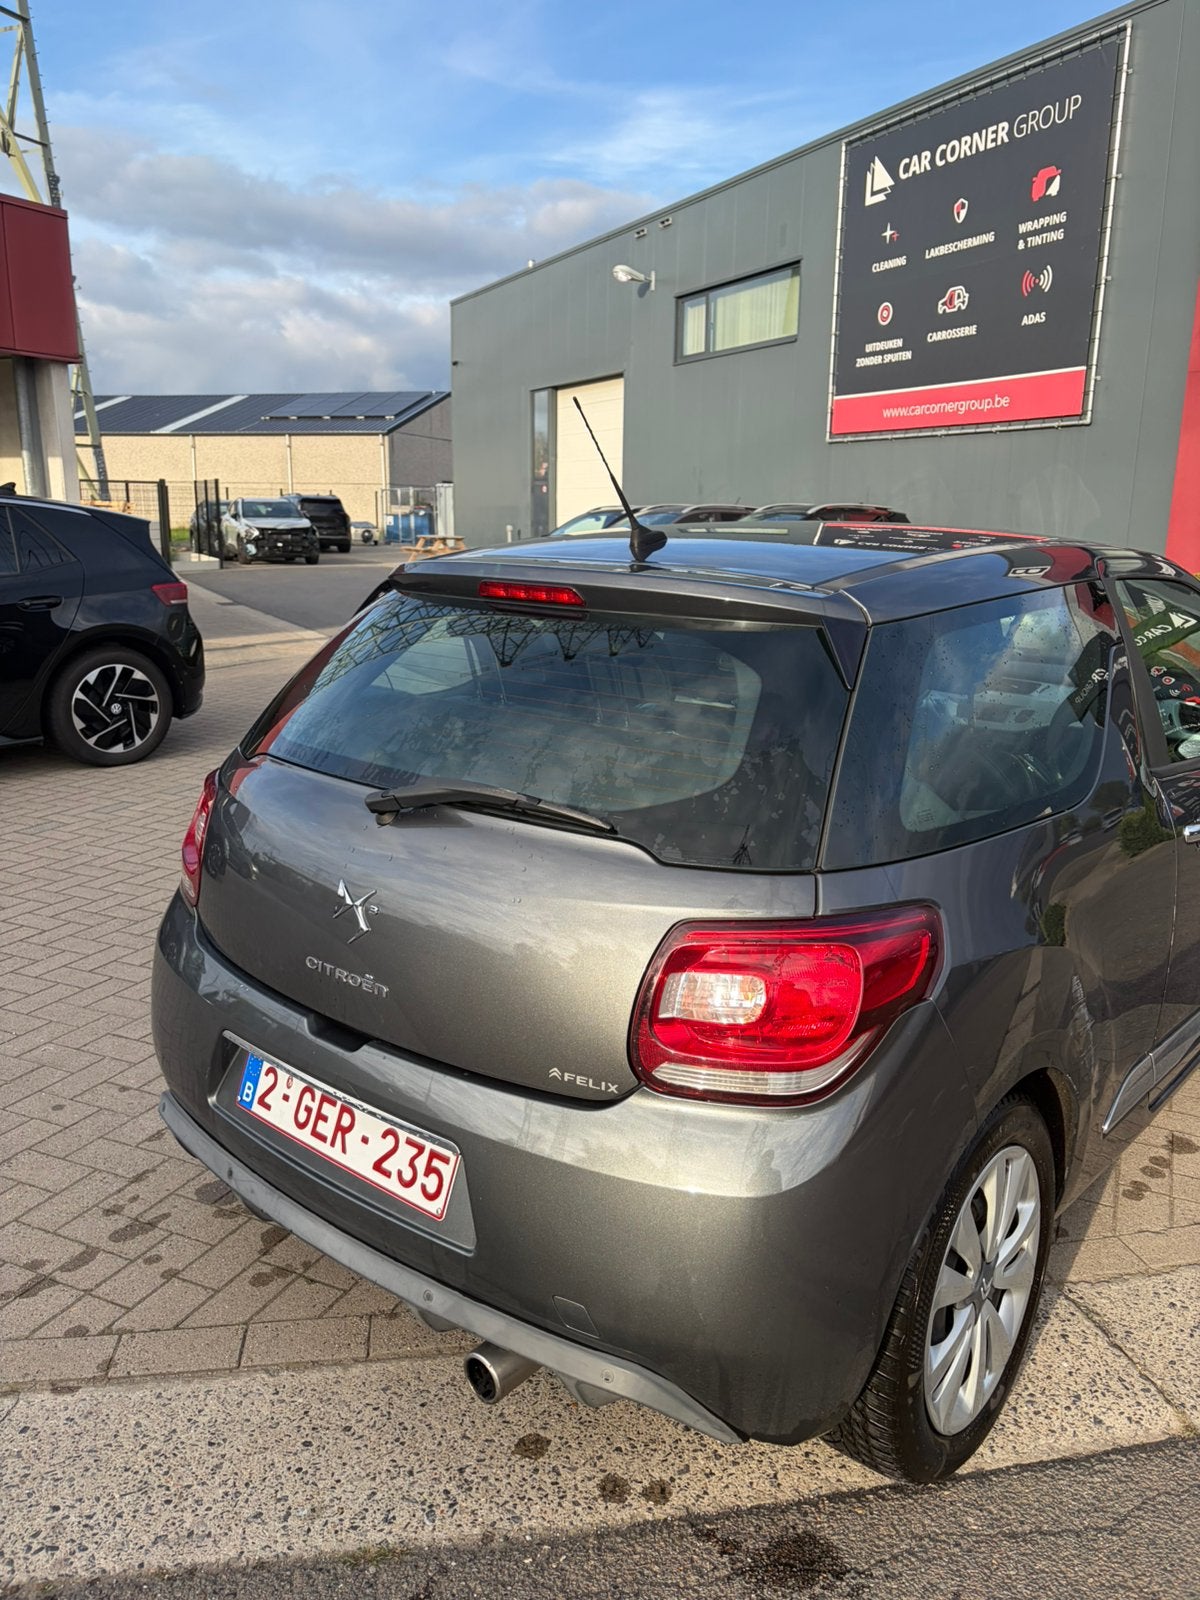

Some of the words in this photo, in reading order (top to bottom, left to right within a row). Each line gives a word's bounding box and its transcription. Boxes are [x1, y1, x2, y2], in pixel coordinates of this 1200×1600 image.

[898, 150, 932, 180] CAR
[935, 121, 1010, 167] CORNER
[1013, 94, 1082, 138] GROUP
[1018, 211, 1067, 234] WRAPPING
[925, 231, 995, 260] LAKBESCHERMING
[1017, 239, 1025, 250] &
[1027, 228, 1065, 248] TINTING
[871, 255, 907, 273] CLEANING
[1021, 311, 1046, 326] ADAS
[926, 324, 977, 343] CARROSSERIE
[865, 338, 903, 353] UITDEUKEN
[855, 354, 883, 368] ZONDER
[883, 350, 912, 364] SPUITEN
[882, 394, 1011, 418] www.carcornergroup.be
[305, 955, 390, 998] CITROËN
[242, 1081, 255, 1103] B
[563, 1072, 619, 1094] FELIX
